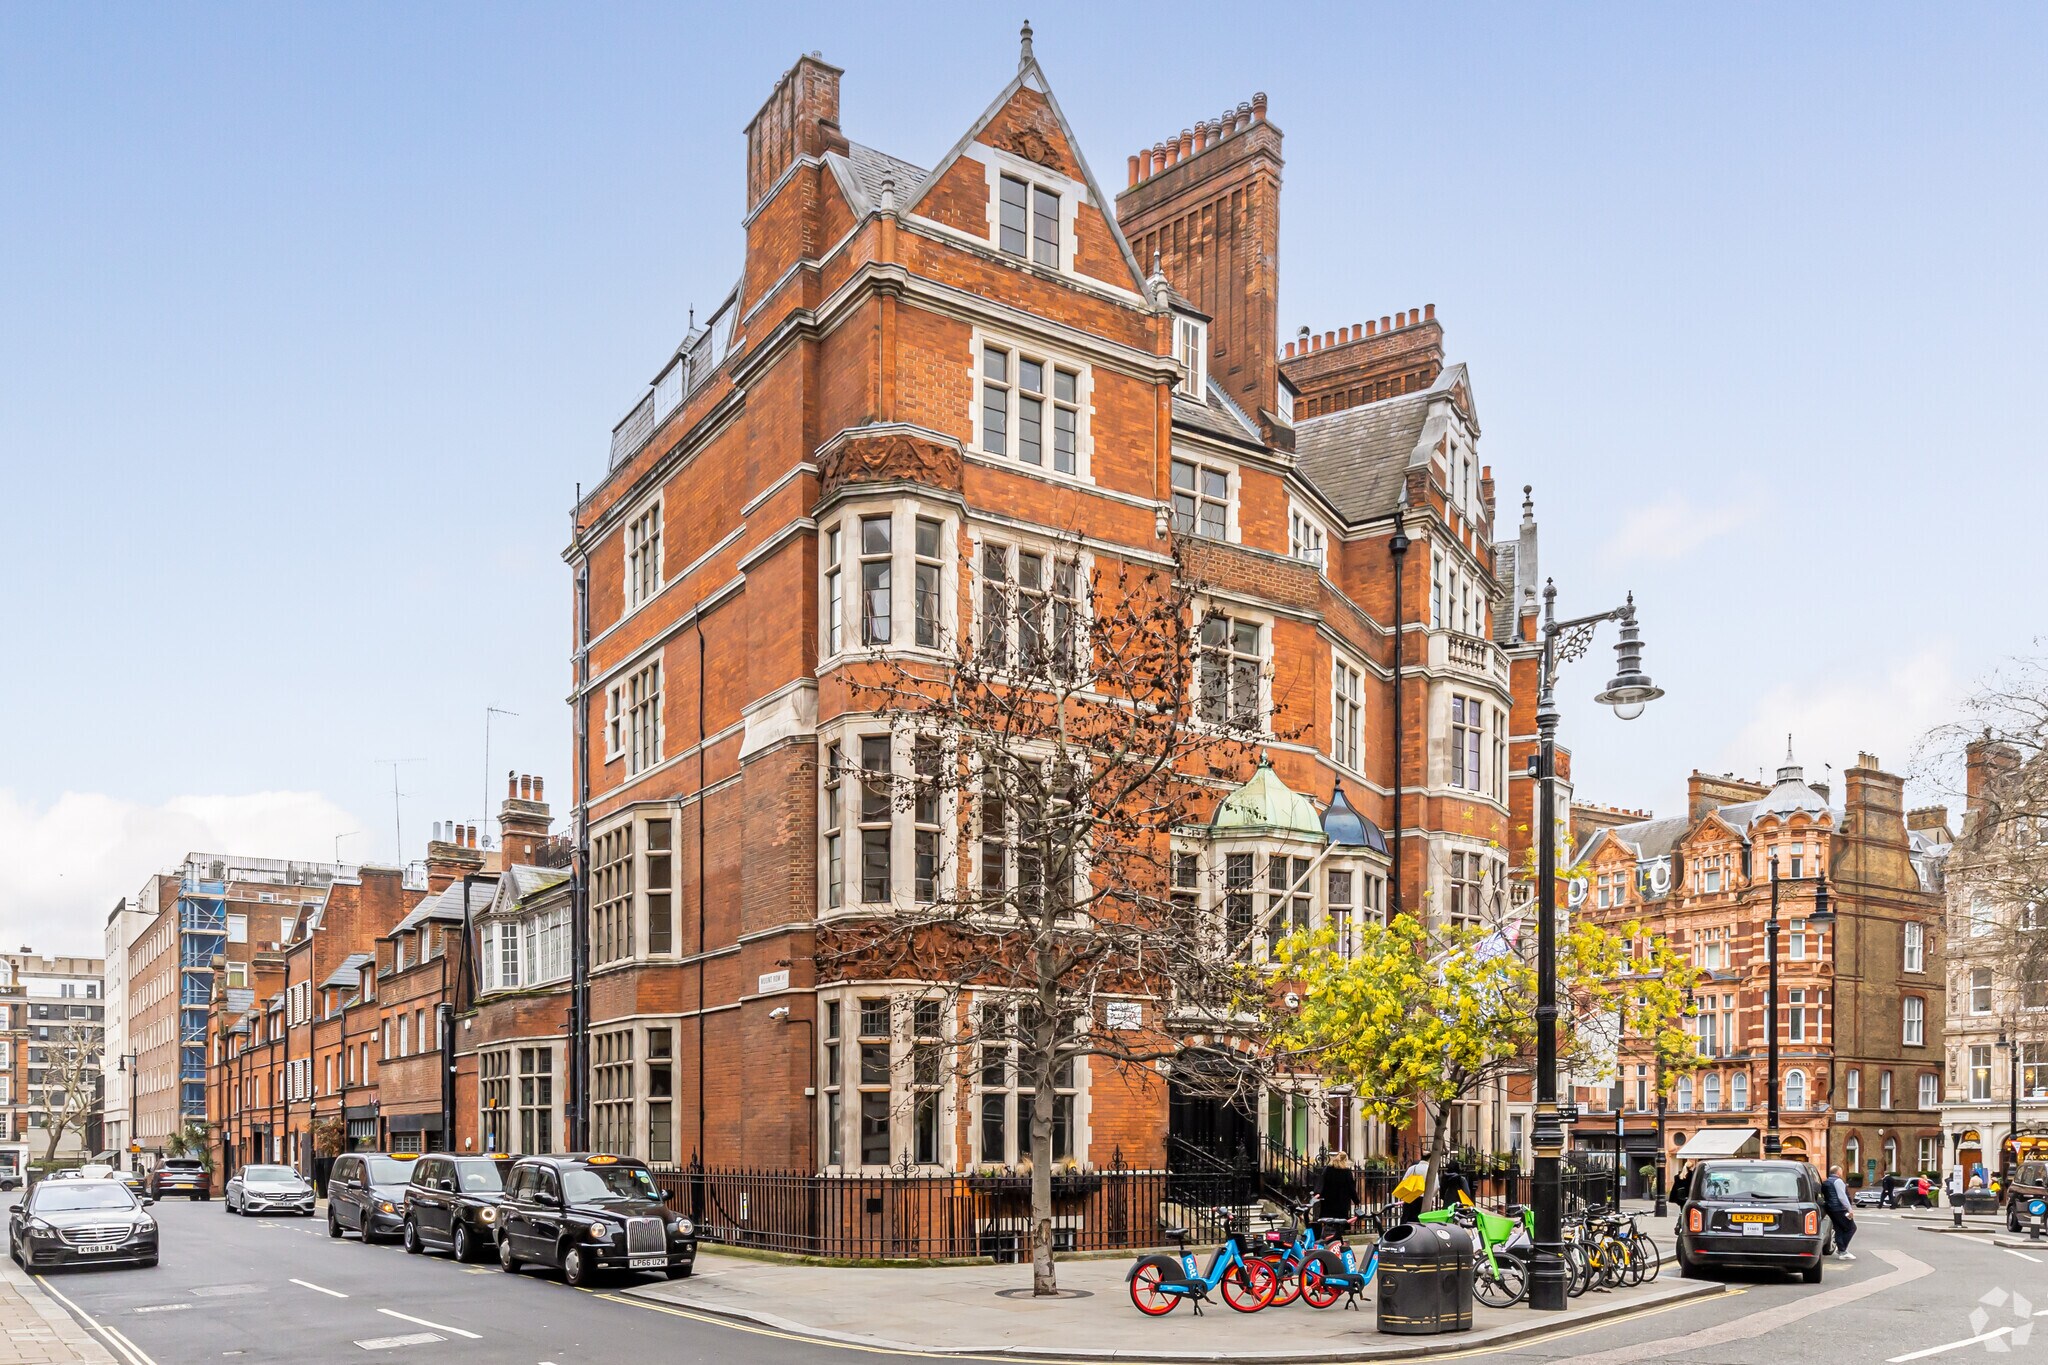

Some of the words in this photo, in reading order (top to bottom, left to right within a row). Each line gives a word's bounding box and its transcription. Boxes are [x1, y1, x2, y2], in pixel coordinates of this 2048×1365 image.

[100, 1244, 114, 1252] LRA
[632, 1259, 651, 1267] LP66
[1186, 1257, 1198, 1279] dott
[1346, 1252, 1356, 1274] dott
